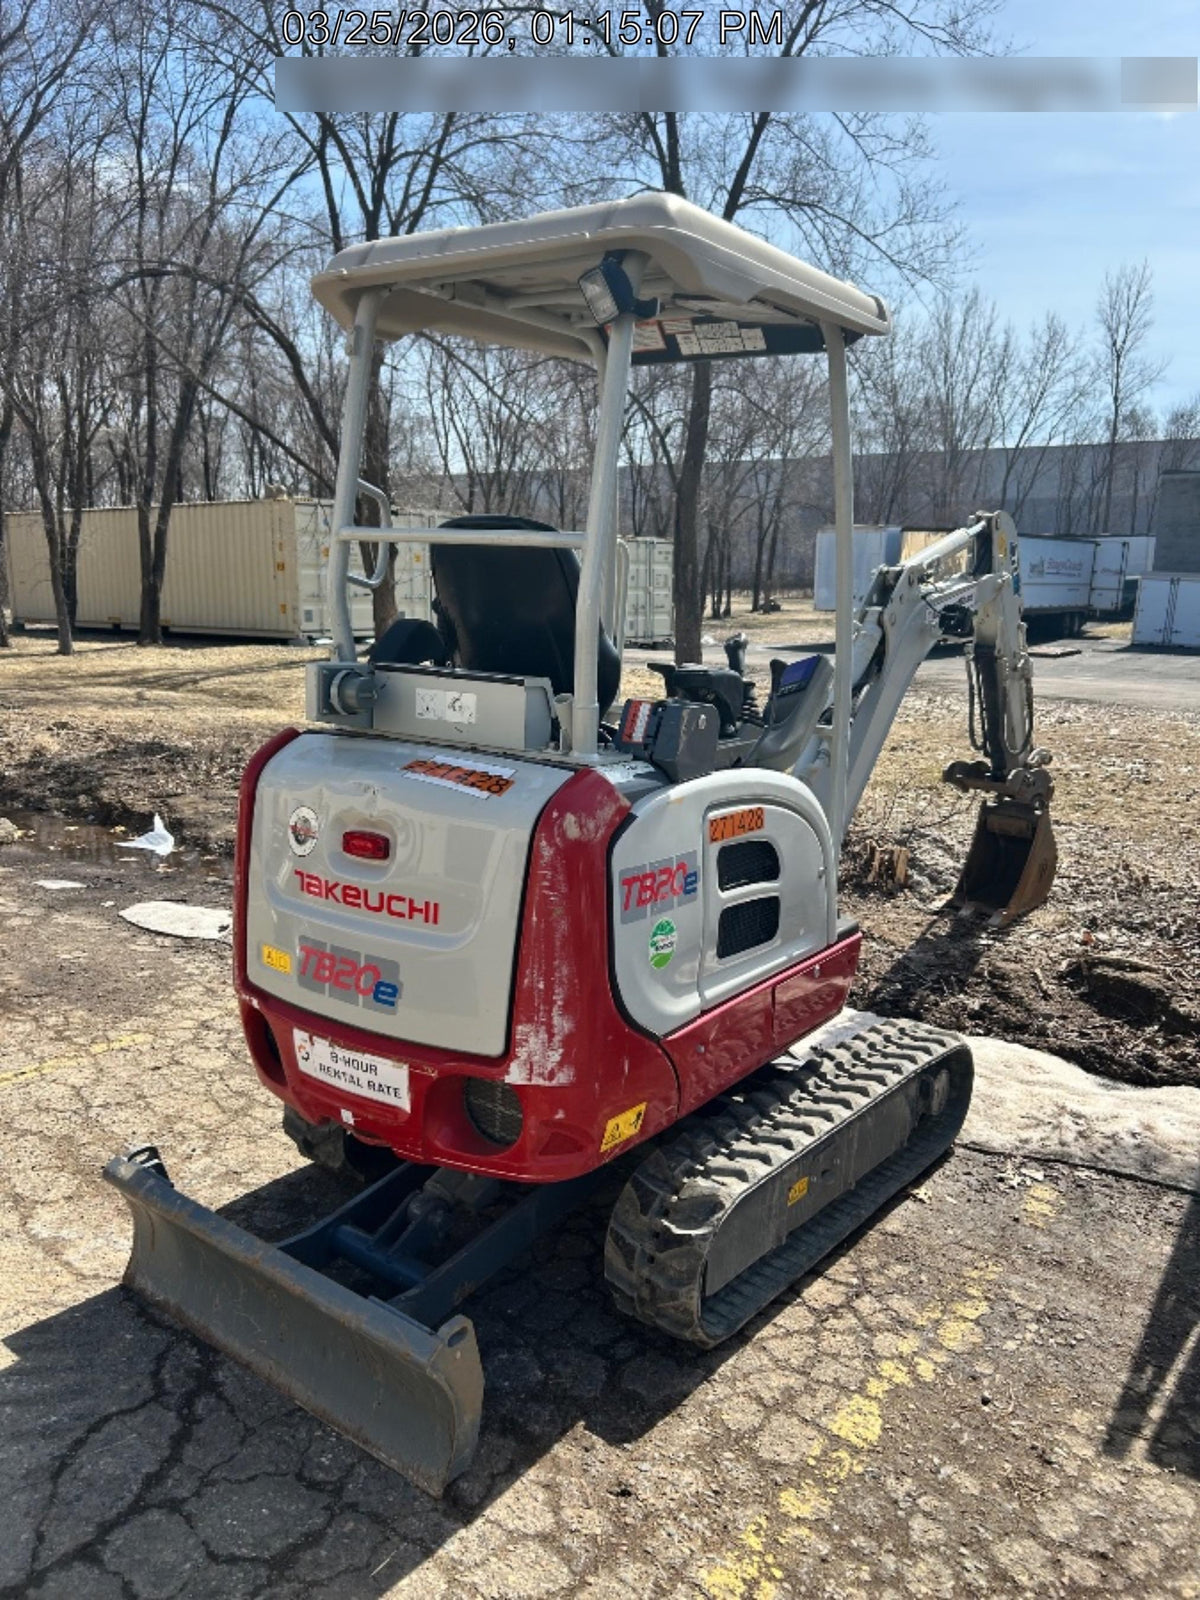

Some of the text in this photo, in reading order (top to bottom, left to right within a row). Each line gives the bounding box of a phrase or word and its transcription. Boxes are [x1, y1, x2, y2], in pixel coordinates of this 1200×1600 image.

[709, 806, 764, 842] 271428
[299, 945, 399, 1007] TB20e
[319, 1062, 402, 1099] RENTAL RATE
[329, 1051, 378, 1076] 8-HOUR
